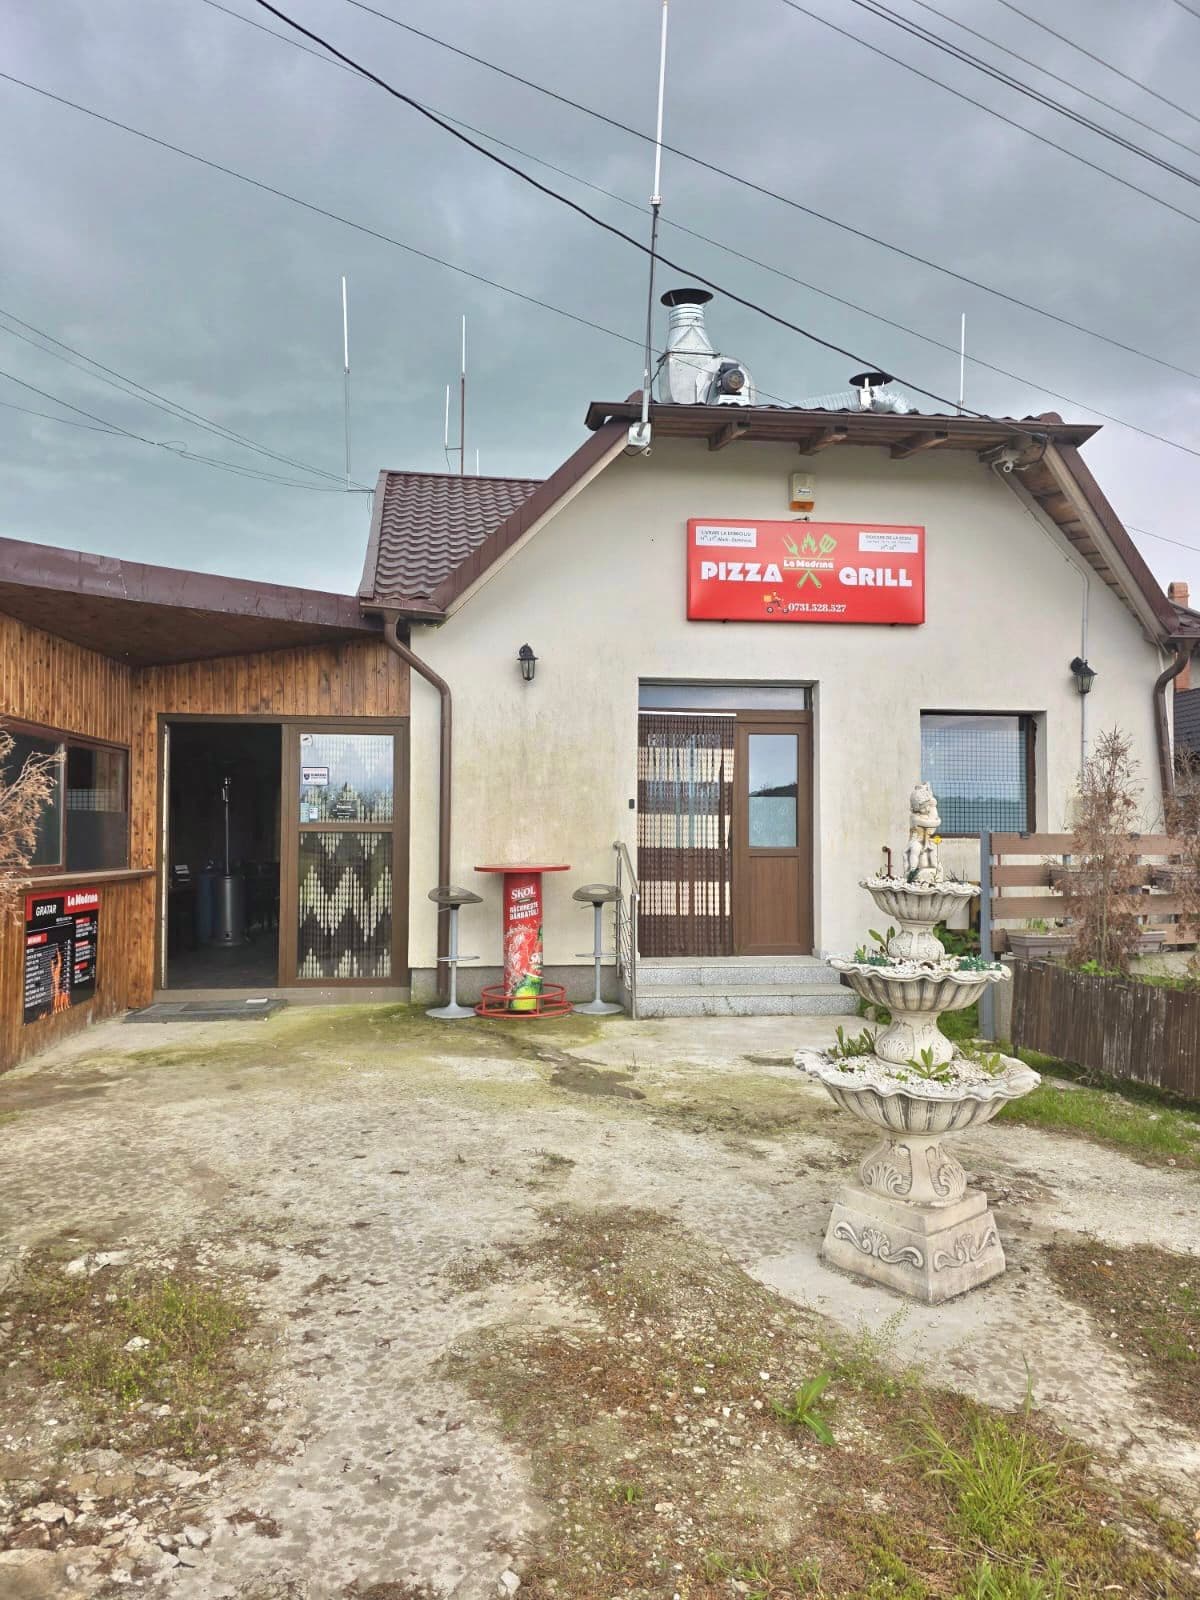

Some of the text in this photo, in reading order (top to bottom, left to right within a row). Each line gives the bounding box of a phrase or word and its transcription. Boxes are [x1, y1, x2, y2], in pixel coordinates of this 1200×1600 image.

[783, 559, 834, 569] La Madrina
[701, 561, 783, 583] PIZZA
[838, 567, 912, 587] GRILL
[788, 603, 846, 613] 0731.528.527
[511, 886, 537, 900] SKOL
